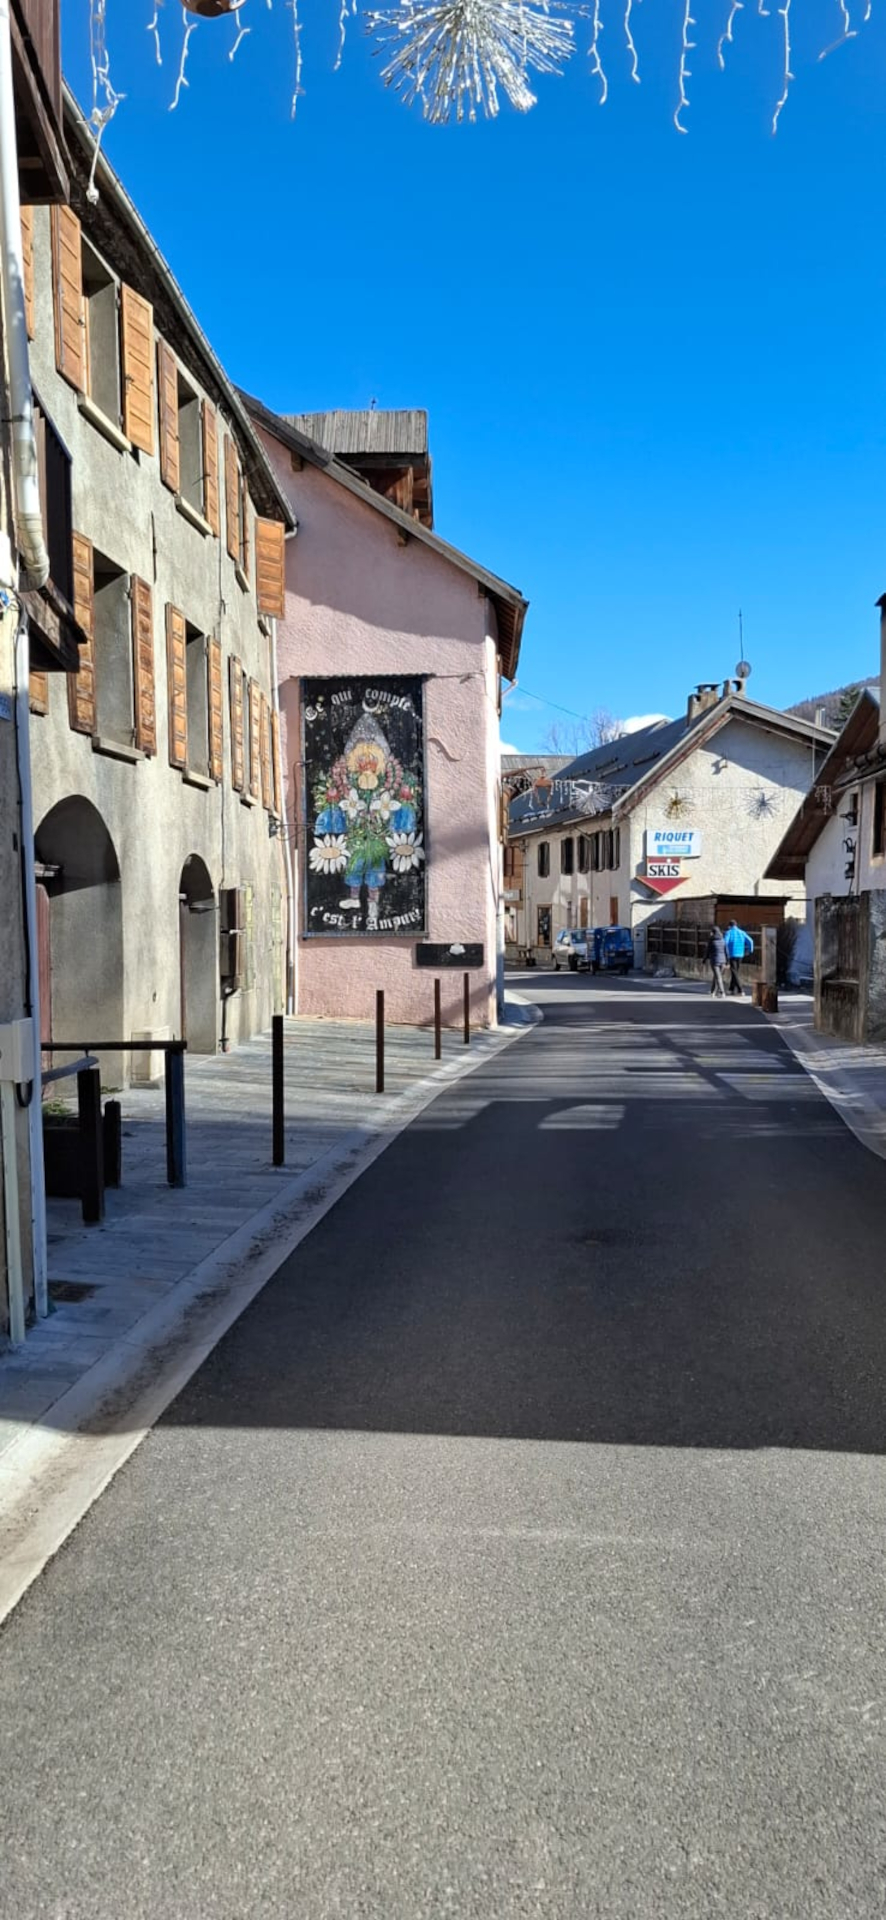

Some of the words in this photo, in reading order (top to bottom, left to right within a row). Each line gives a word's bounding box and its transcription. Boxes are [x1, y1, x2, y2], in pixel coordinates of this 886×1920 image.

[330, 690, 352, 706] qui
[654, 832, 695, 842] RIQUET
[649, 864, 680, 876] SKIS
